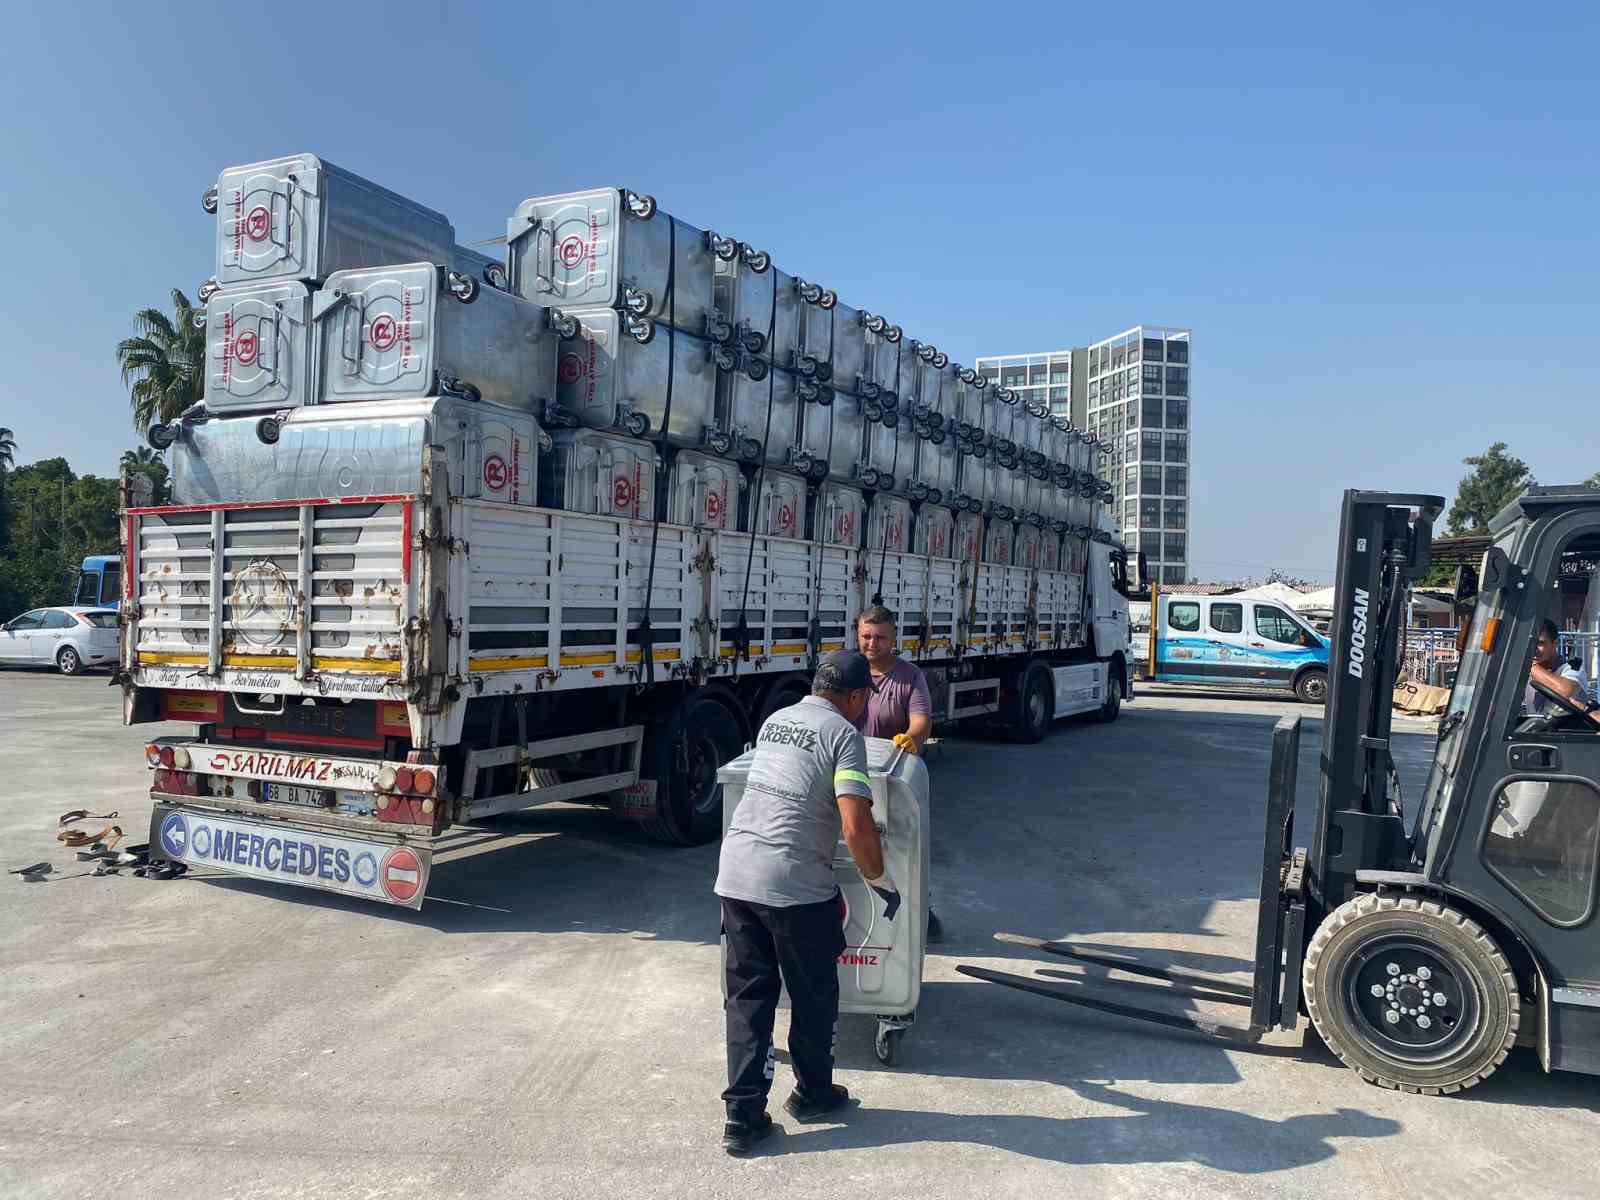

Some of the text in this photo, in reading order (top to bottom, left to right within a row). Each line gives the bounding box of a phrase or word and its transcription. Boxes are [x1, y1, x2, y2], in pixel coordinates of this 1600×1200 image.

[1348, 587, 1370, 679] DOOSAN
[764, 722, 818, 740] SEVDAMIZ
[231, 753, 332, 780] SARILMAZ
[268, 783, 280, 800] 68
[288, 787, 300, 803] BA
[213, 829, 350, 882] MERCEDES
